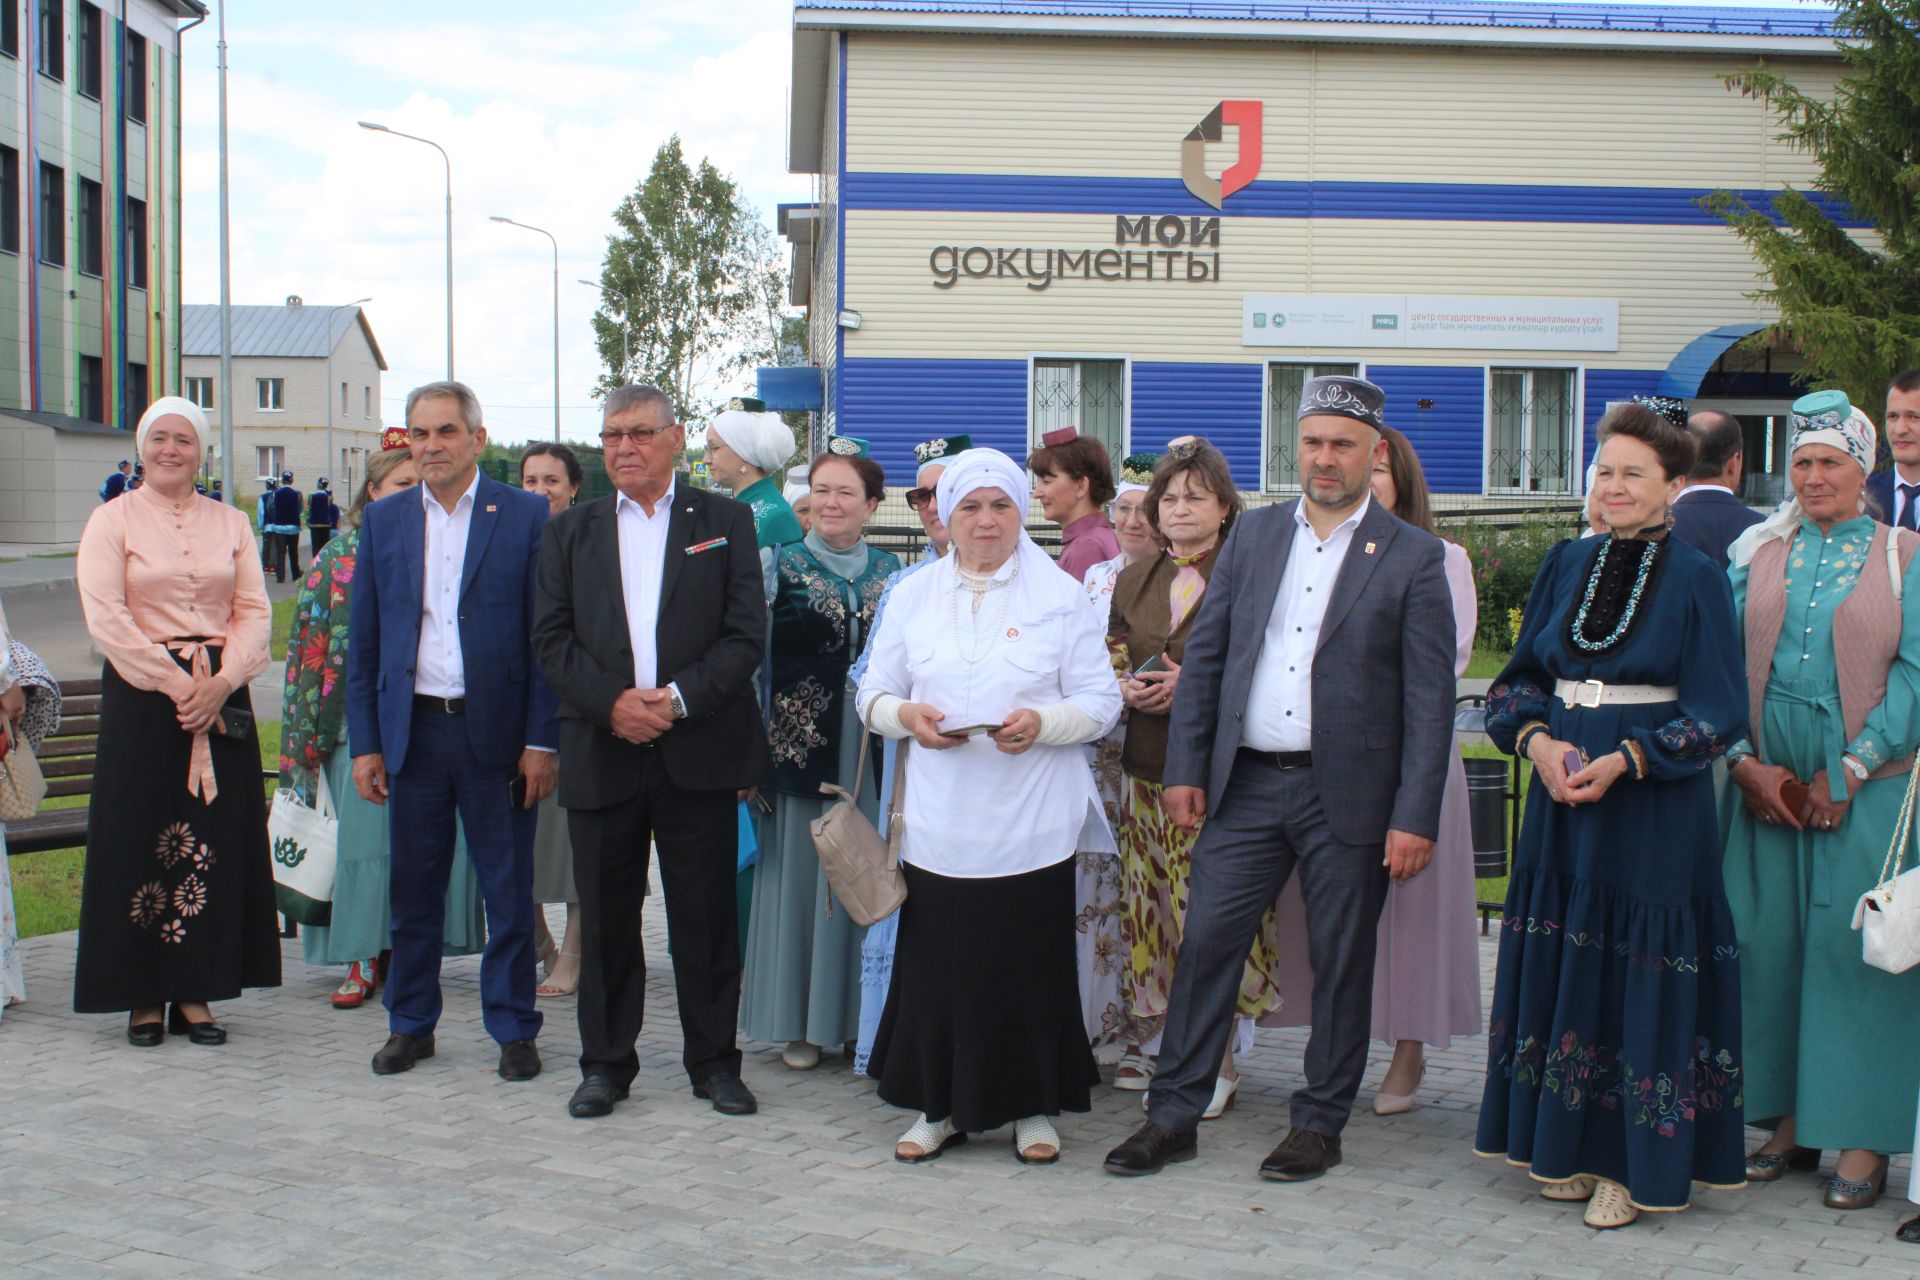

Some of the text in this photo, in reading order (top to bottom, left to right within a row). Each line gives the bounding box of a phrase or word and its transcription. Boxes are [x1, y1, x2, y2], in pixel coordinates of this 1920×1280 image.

[929, 245, 1220, 290] документы
[1376, 317, 1394, 326] МФЦ
[1411, 313, 1435, 322] центр
[1437, 314, 1506, 323] государственных
[1516, 316, 1581, 325] муниципальных
[1583, 317, 1604, 326] услуг
